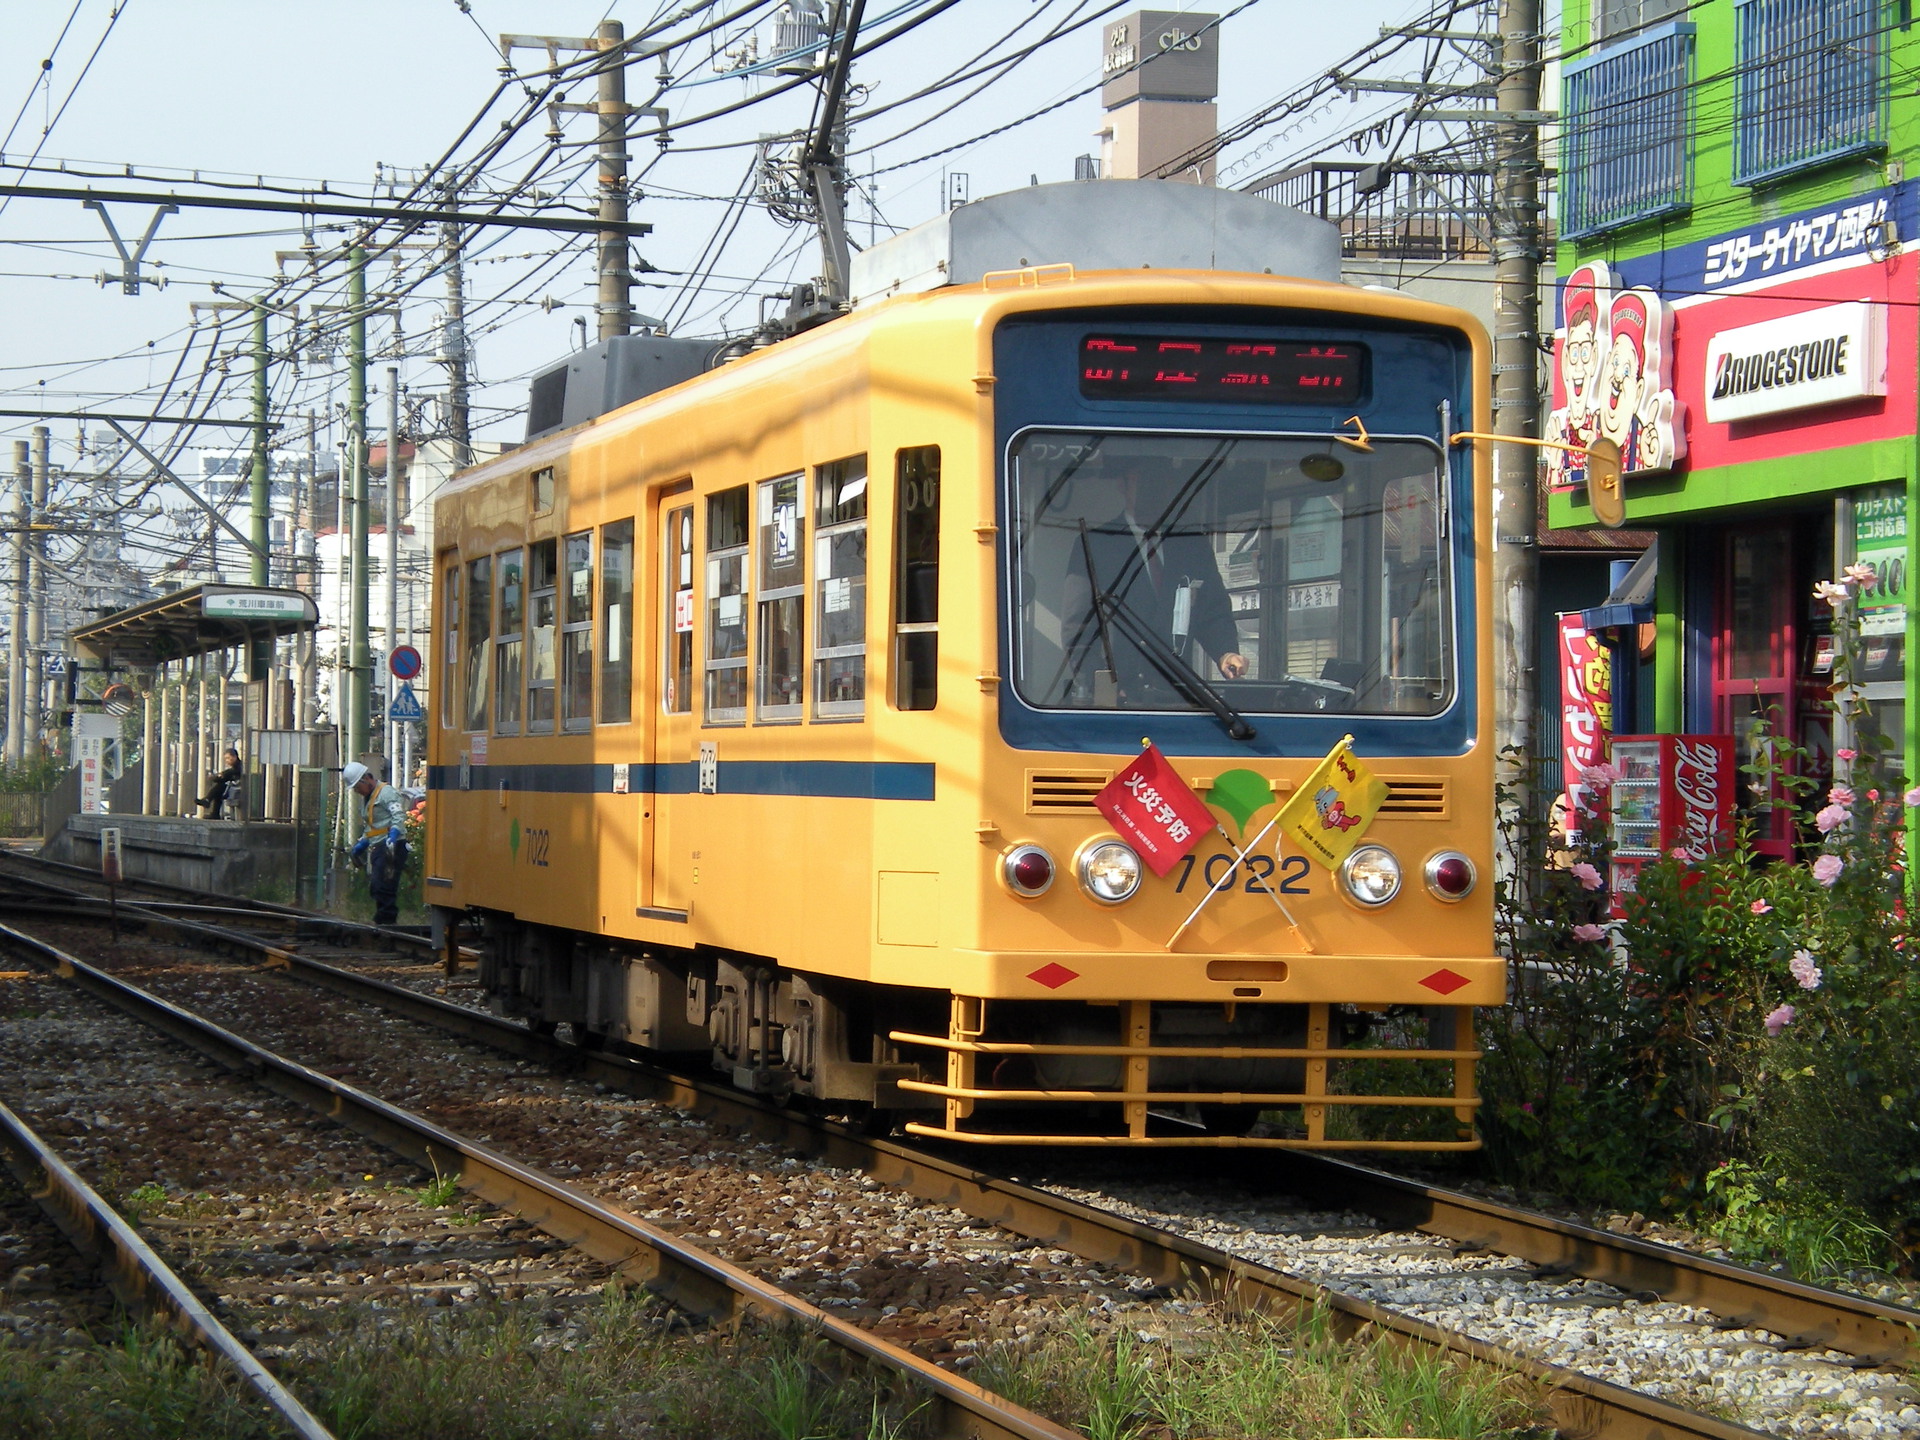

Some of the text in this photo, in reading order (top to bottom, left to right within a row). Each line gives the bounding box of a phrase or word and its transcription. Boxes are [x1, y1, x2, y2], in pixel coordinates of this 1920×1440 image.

[1712, 335, 1848, 399] BRIDGESTONE
[1032, 444, 1100, 462] ワンマン
[1123, 771, 1192, 843] 火災予防
[525, 828, 550, 867] 7022
[1175, 853, 1311, 895] 7022
